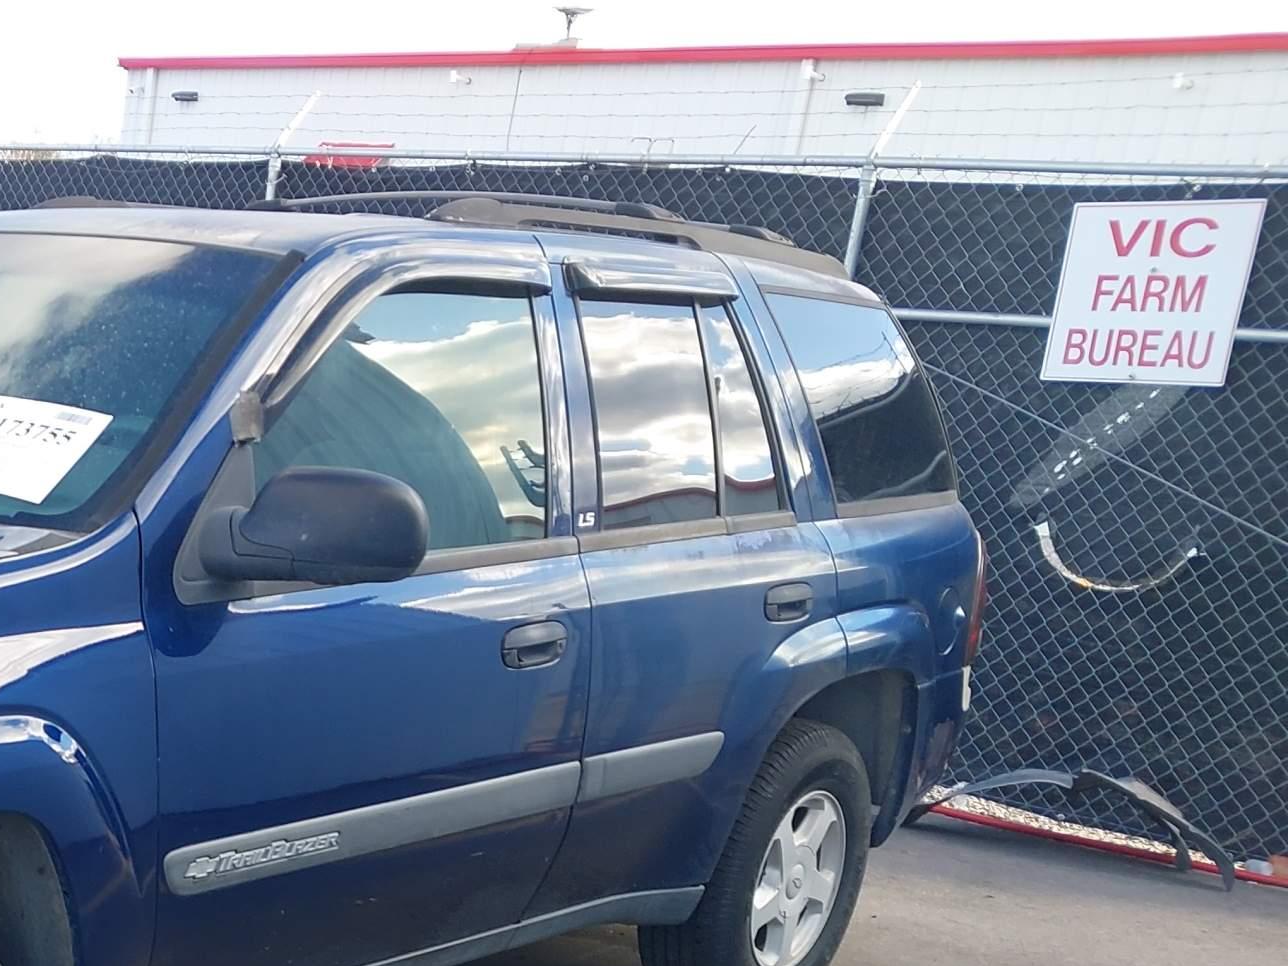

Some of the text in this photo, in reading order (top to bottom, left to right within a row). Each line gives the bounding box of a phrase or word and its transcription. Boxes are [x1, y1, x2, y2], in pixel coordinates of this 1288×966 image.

[1108, 217, 1220, 259] VIC
[1090, 274, 1209, 313] FARM
[1062, 328, 1216, 370] BUREAU
[577, 511, 596, 528] LS
